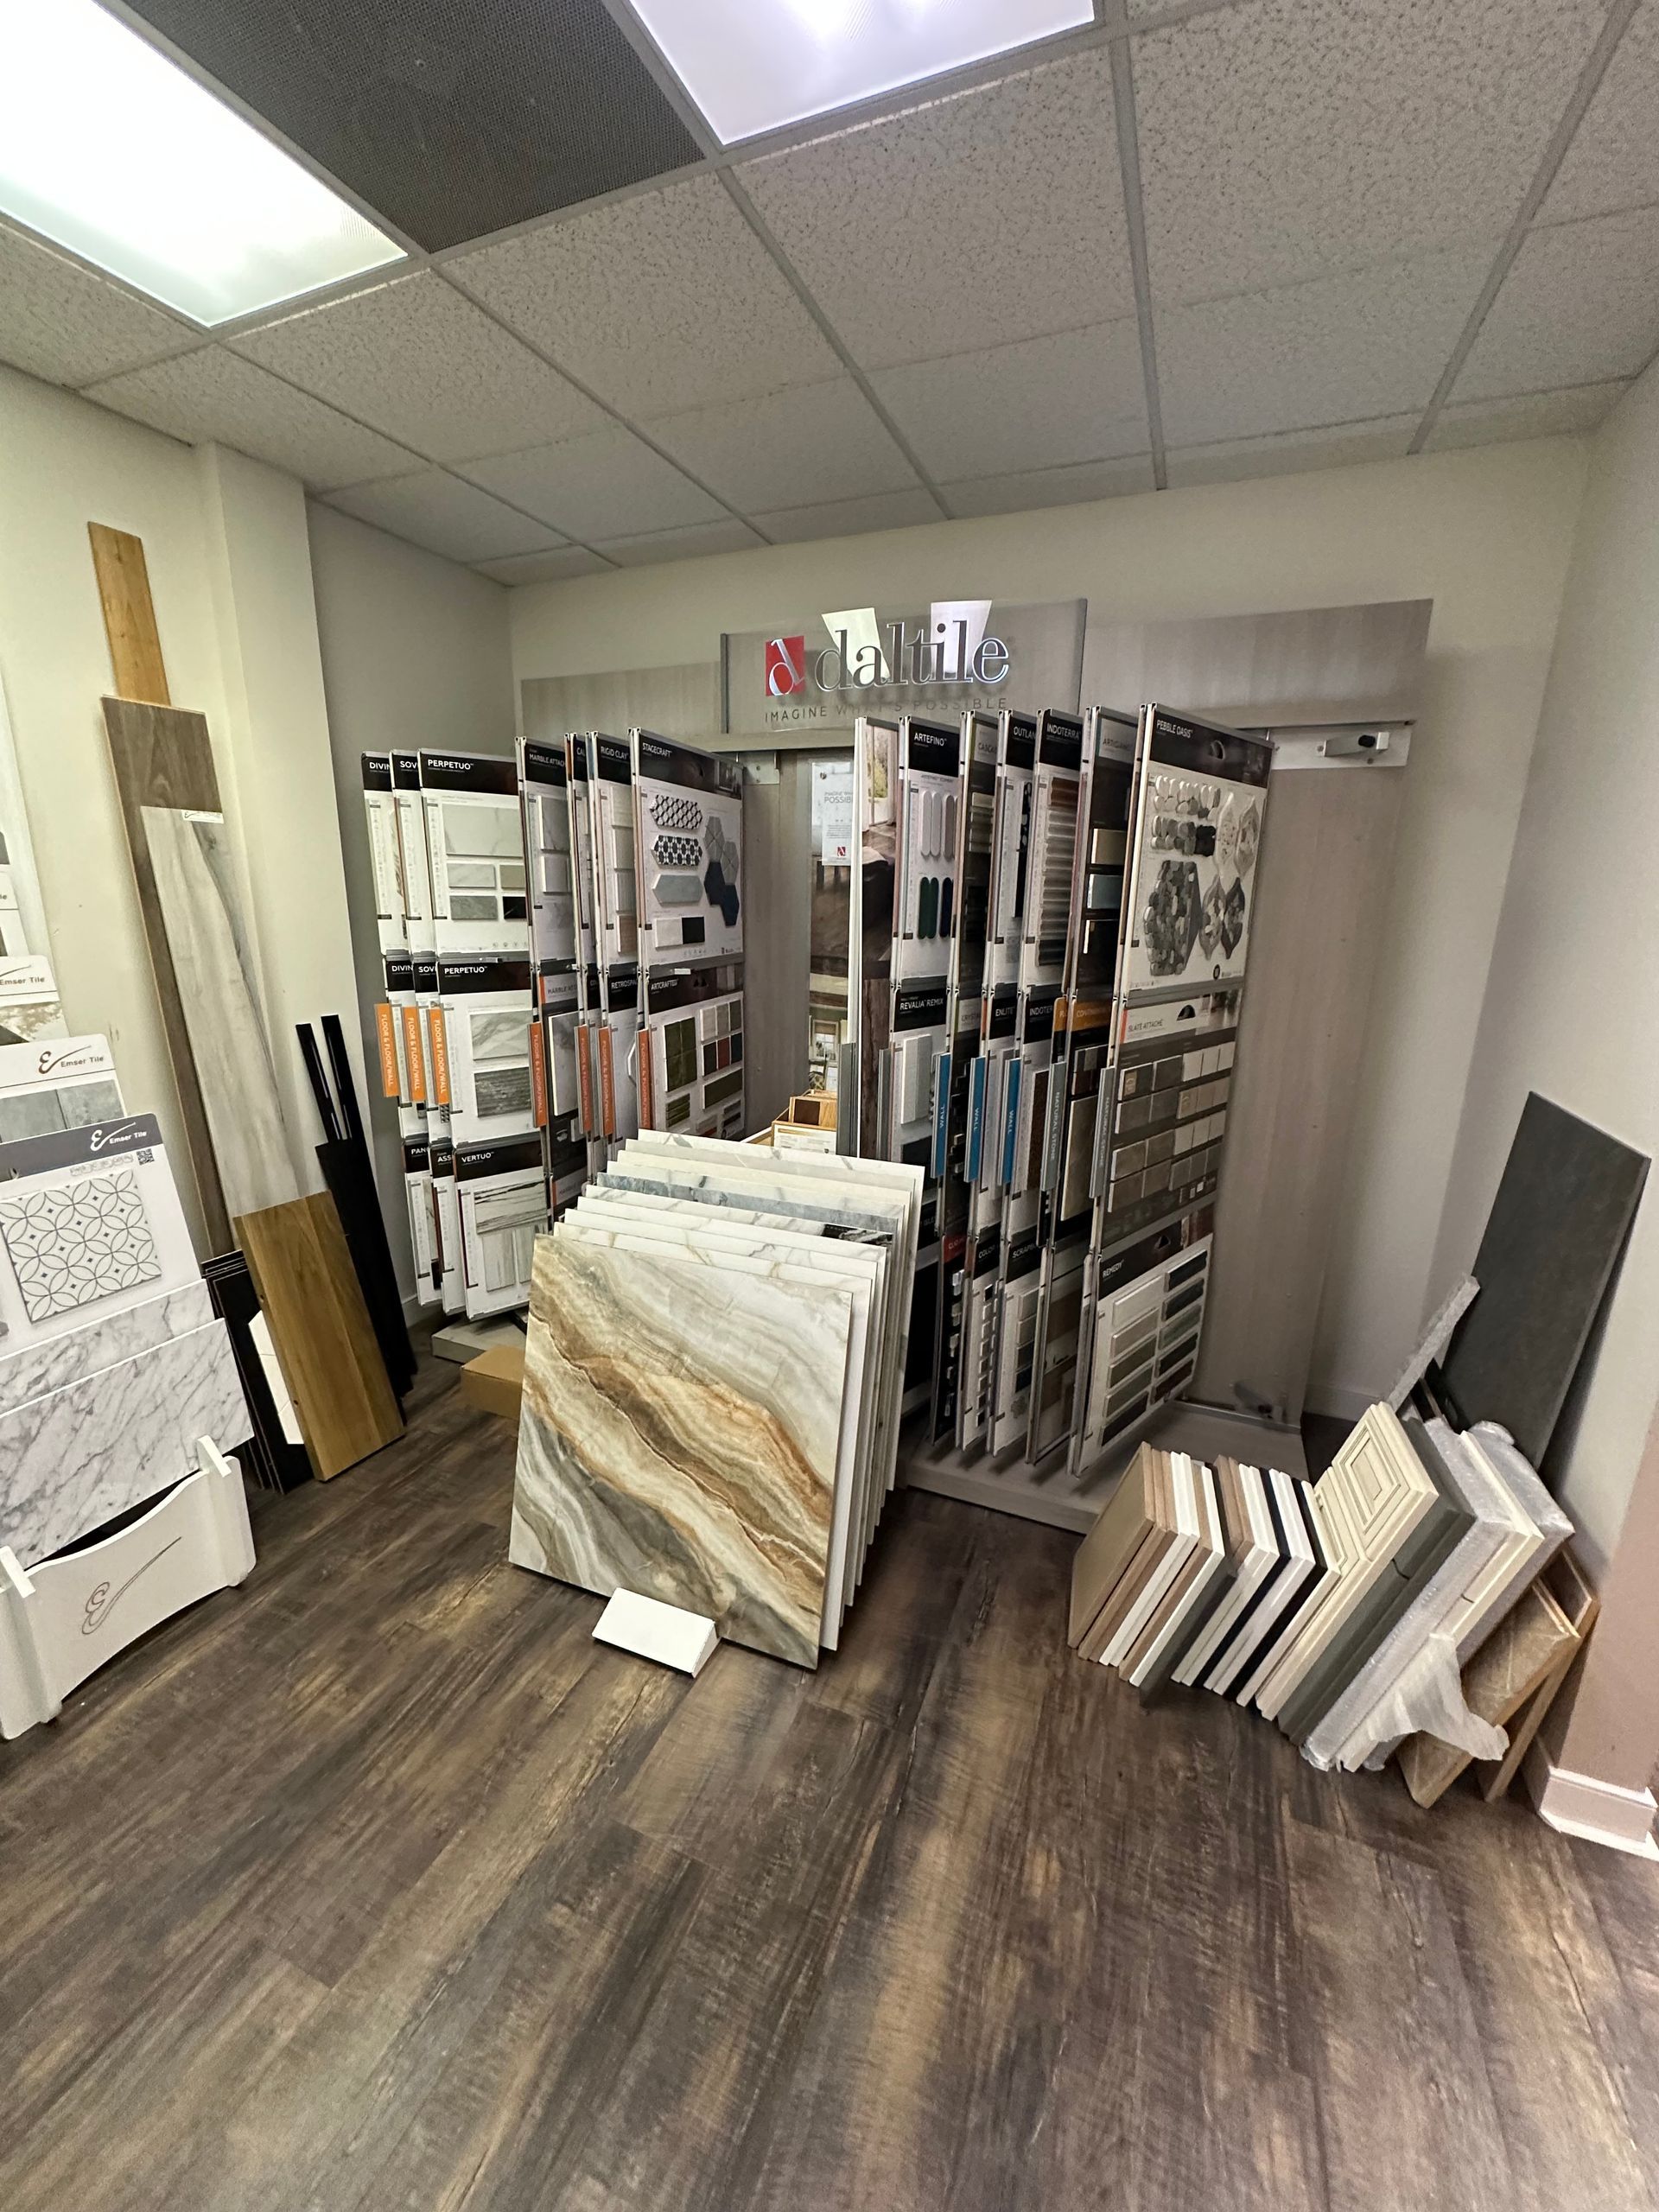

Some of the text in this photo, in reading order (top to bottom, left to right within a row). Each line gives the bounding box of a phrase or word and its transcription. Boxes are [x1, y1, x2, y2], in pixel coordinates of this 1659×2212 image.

[815, 617, 1009, 692] daltile
[765, 706, 827, 723] IMAGINE
[912, 697, 1007, 711] POSSIBLE
[1156, 719, 1192, 739] PEBBLE OASIS
[913, 732, 944, 747] ARTEFINO
[529, 753, 550, 764] MARBLE
[434, 1020, 442, 1043] FLOOR
[60, 1059, 86, 1068] Emser
[109, 1134, 131, 1144] Emser
[134, 1130, 147, 1139] Tile
